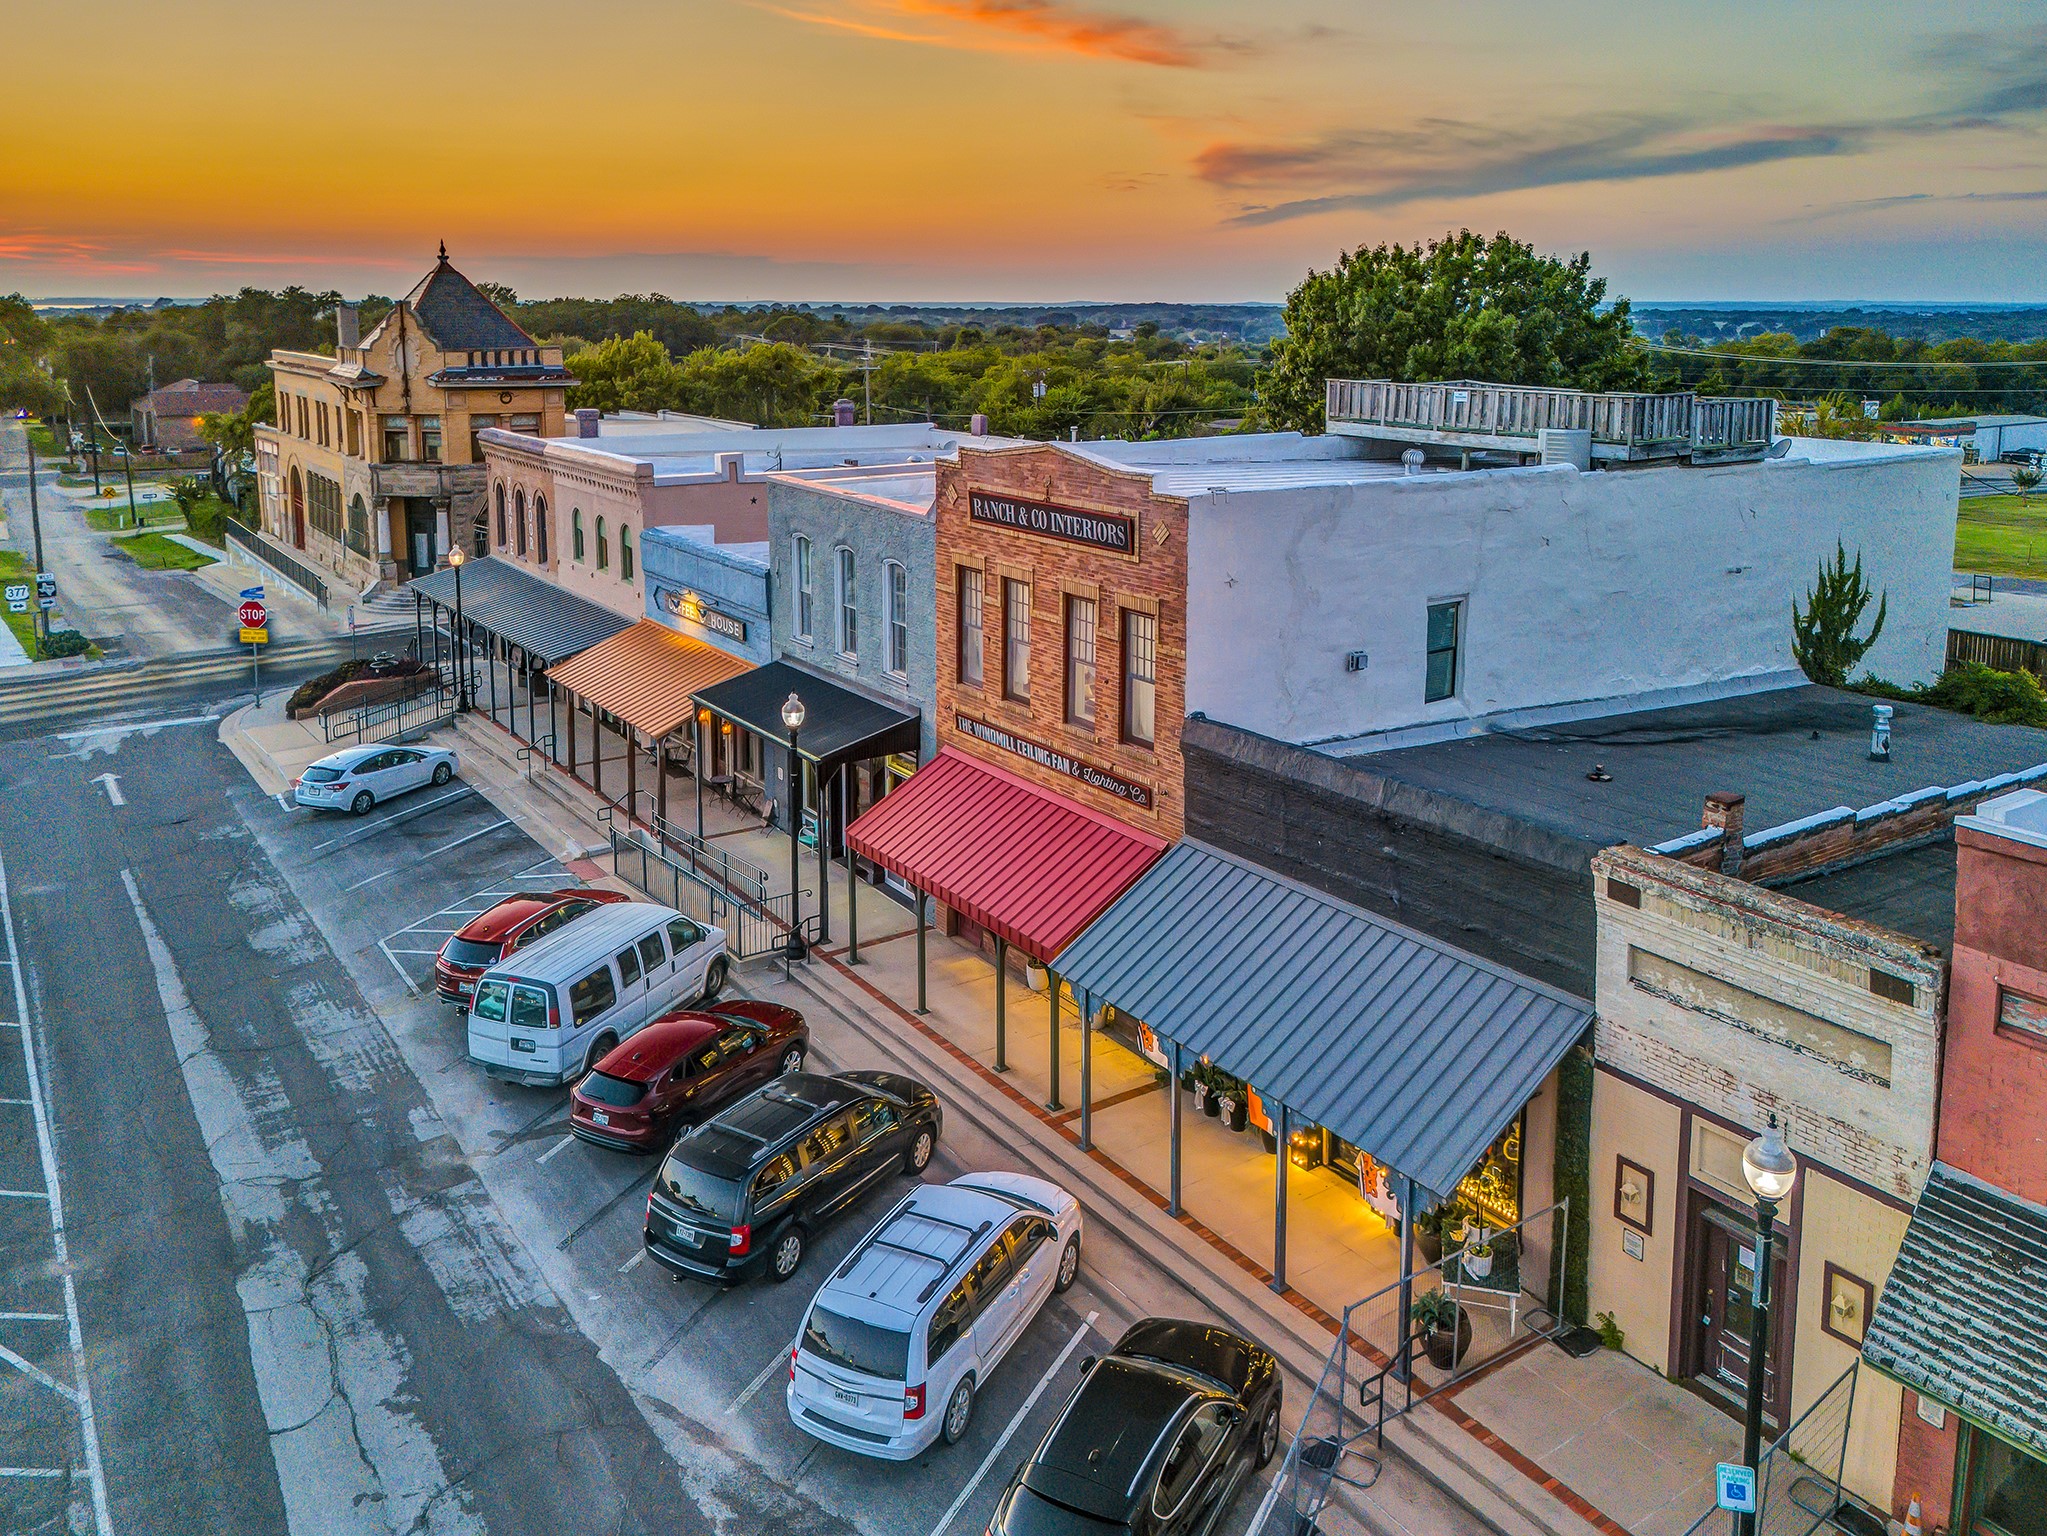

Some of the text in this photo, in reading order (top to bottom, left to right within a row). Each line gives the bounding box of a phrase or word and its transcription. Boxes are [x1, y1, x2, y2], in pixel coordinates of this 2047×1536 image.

[972, 498, 1126, 546] RANCH & CO INTERIORS
[8, 587, 26, 597] 377
[240, 609, 265, 620] STOP
[711, 614, 740, 637] HOUSE
[957, 715, 1146, 804] THE WINDMILL CEILING FAN & Lighting Co
[1719, 1465, 1753, 1477] RESERVED
[1722, 1473, 1750, 1485] PARKING
